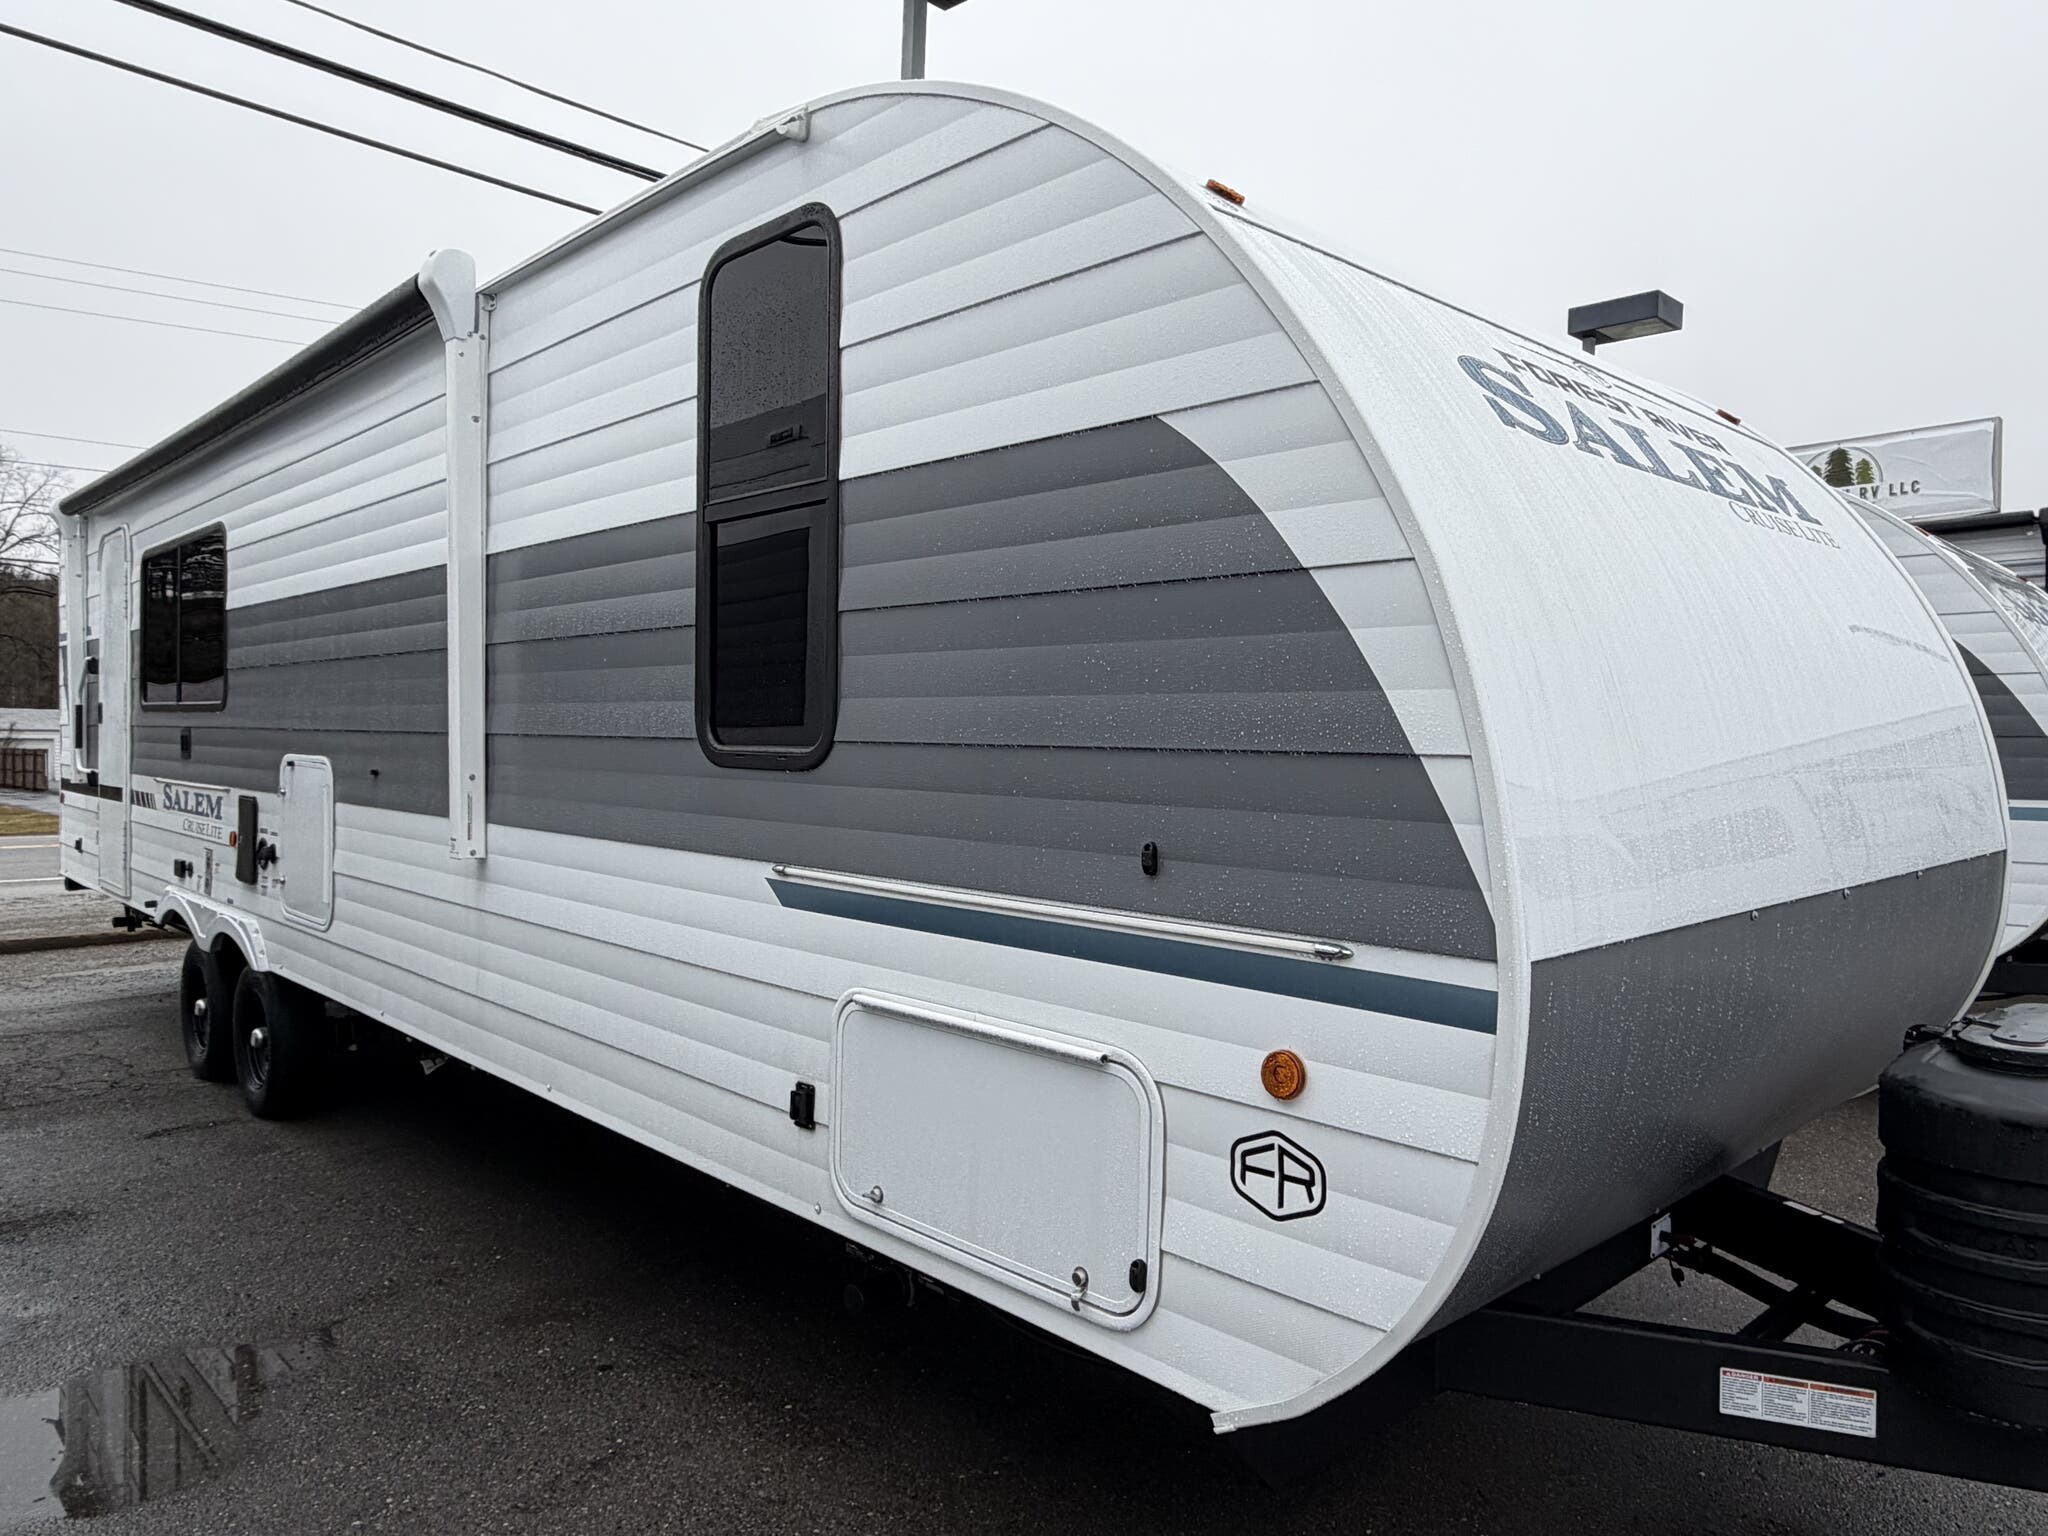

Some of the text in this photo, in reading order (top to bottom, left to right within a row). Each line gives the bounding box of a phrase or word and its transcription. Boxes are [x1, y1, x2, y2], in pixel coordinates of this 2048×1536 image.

[1494, 348, 1640, 420] FOREST
[1638, 407, 1732, 455] RIVER
[1457, 354, 1823, 526] SALEM
[1859, 486, 1880, 500] RV
[1889, 480, 1921, 496] LLC
[163, 783, 223, 820] SALEM
